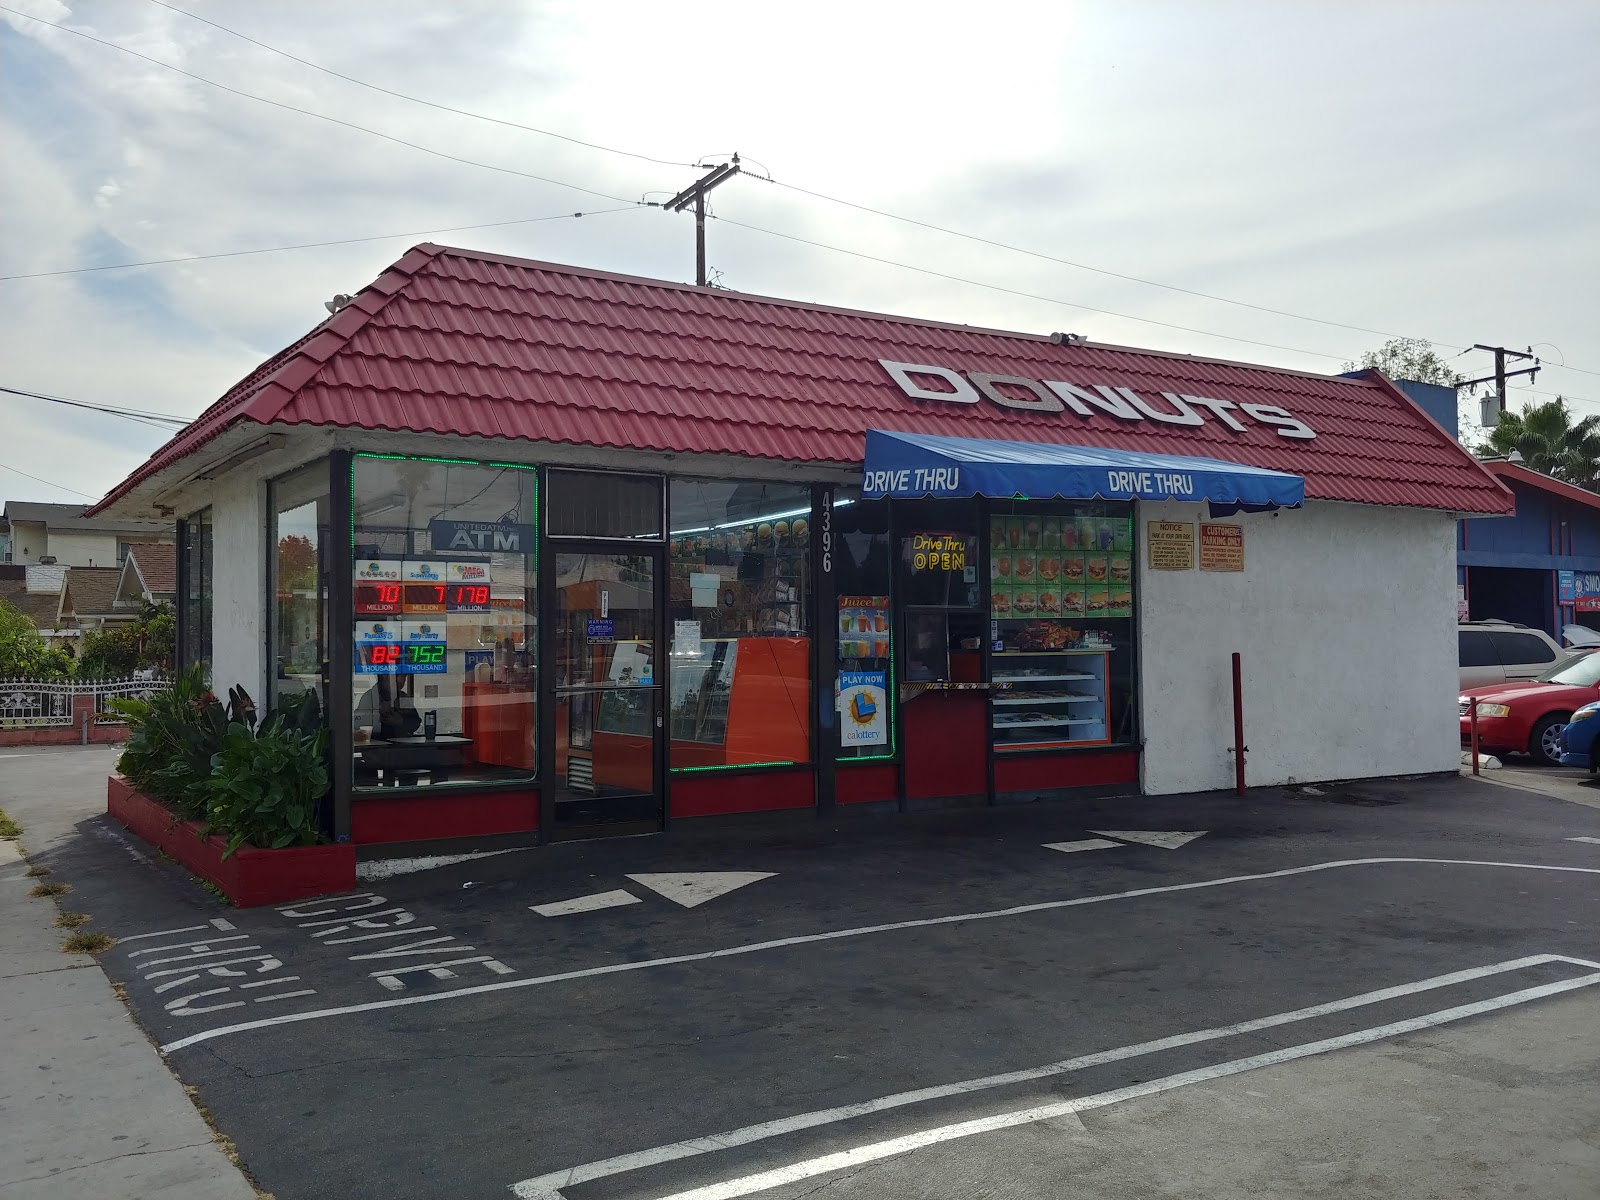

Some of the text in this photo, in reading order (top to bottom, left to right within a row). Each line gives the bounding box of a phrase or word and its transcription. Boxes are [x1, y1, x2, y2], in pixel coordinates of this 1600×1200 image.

[878, 358, 1317, 440] DONUTS
[863, 467, 959, 492] DRIVE THRU
[1107, 470, 1193, 494] DRIVE THRU
[448, 529, 519, 550] ATM
[822, 491, 831, 573] 4396
[1203, 536, 1241, 546] PARKING ONLY
[913, 535, 965, 552] Drive Thru
[914, 552, 965, 570] OPEN
[376, 585, 400, 603] 70
[434, 585, 445, 603] 7
[457, 586, 489, 604] 178
[841, 597, 872, 607] Juice
[372, 645, 400, 664] 82
[408, 645, 445, 663] 752
[842, 675, 883, 684] PLAY NOW
[847, 730, 880, 740] calottery
[274, 893, 516, 991] DRIVE
